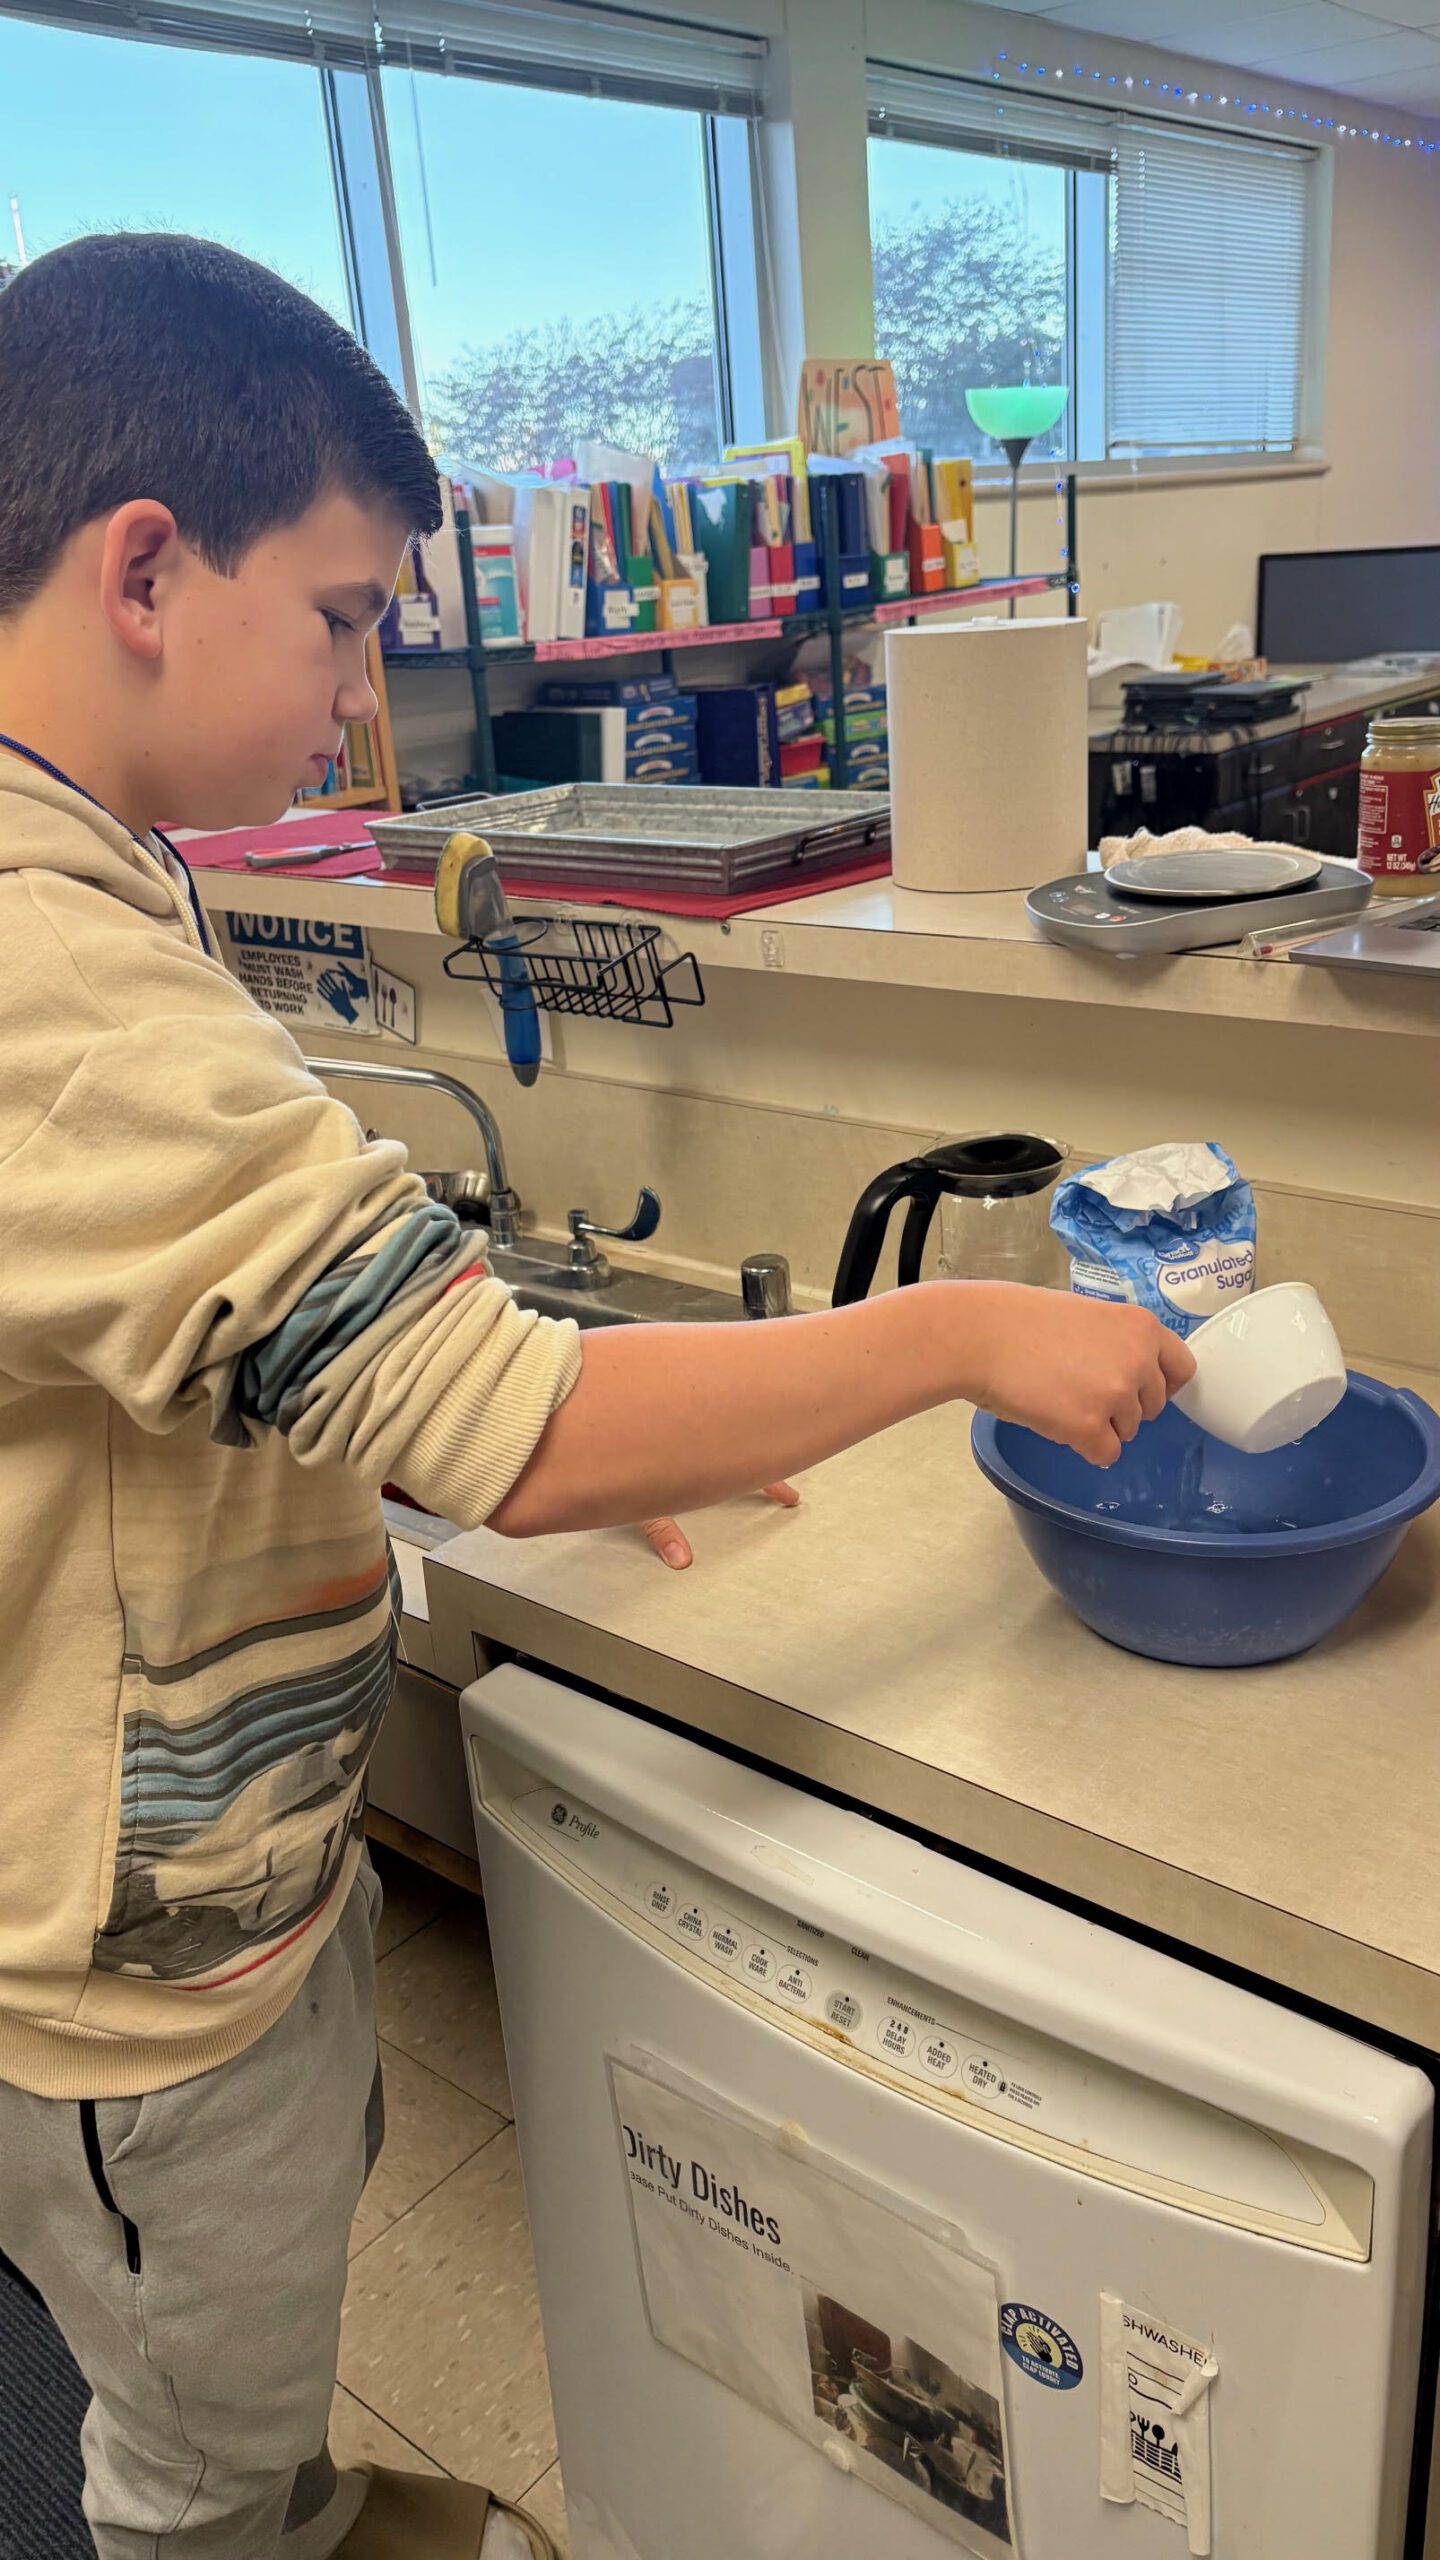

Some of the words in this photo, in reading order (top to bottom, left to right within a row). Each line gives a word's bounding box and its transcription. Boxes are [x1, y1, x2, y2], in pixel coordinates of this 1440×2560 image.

[234, 911, 354, 950] NOTICE
[240, 950, 300, 967] EMPLOYEES
[242, 962, 271, 976] MUST
[274, 965, 304, 980] WASH
[239, 973, 273, 988] HANDS
[276, 977, 314, 994] BEFORE
[250, 986, 307, 1004] RETURNING
[275, 1002, 304, 1015] WORK
[1165, 1249, 1253, 1285] Granulated
[1217, 1269, 1253, 1290] Suga
[569, 1815, 600, 1839] Profile
[651, 1900, 667, 1912] ONLY
[652, 1891, 670, 1905] RINSE
[678, 1918, 702, 1937] CRYSTAL
[683, 1912, 702, 1927] CHINA
[797, 1920, 824, 1938] SANITIZED
[713, 1931, 738, 1950] NORMAL
[714, 1940, 733, 1956] WASH
[751, 1954, 769, 1968] COOK
[786, 1945, 819, 1967] SELECTIONS
[851, 1946, 870, 1961] CLEAN
[748, 1961, 767, 1977] WARE
[778, 1980, 806, 1999] BACTERIA
[788, 1975, 803, 1987] ANTI
[833, 2000, 855, 2016] START
[887, 1996, 936, 2025] ENHANCEMENTS
[831, 2011, 852, 2028] RESET
[889, 2019, 895, 2028] 2
[897, 2023, 902, 2031] 4
[886, 2029, 907, 2045] DELAY
[882, 2038, 905, 2055] HOURS
[926, 2046, 952, 2063] ADDED
[927, 2055, 946, 2071] HEAT
[969, 2063, 997, 2083] HEATED
[972, 2075, 987, 2089] DRY
[690, 2160, 781, 2245] Dishes
[657, 2185, 677, 2207] Put
[679, 2199, 705, 2224] Dirty
[708, 2217, 749, 2251] Dishes
[752, 2243, 794, 2275] Inside.
[1001, 2308, 1018, 2336] CLAP
[1019, 2307, 1079, 2371] ACTIVATED
[1122, 2314, 1208, 2369] SHWASHE
[1022, 2355, 1030, 2363] TO
[1022, 2362, 1038, 2374] CLAP
